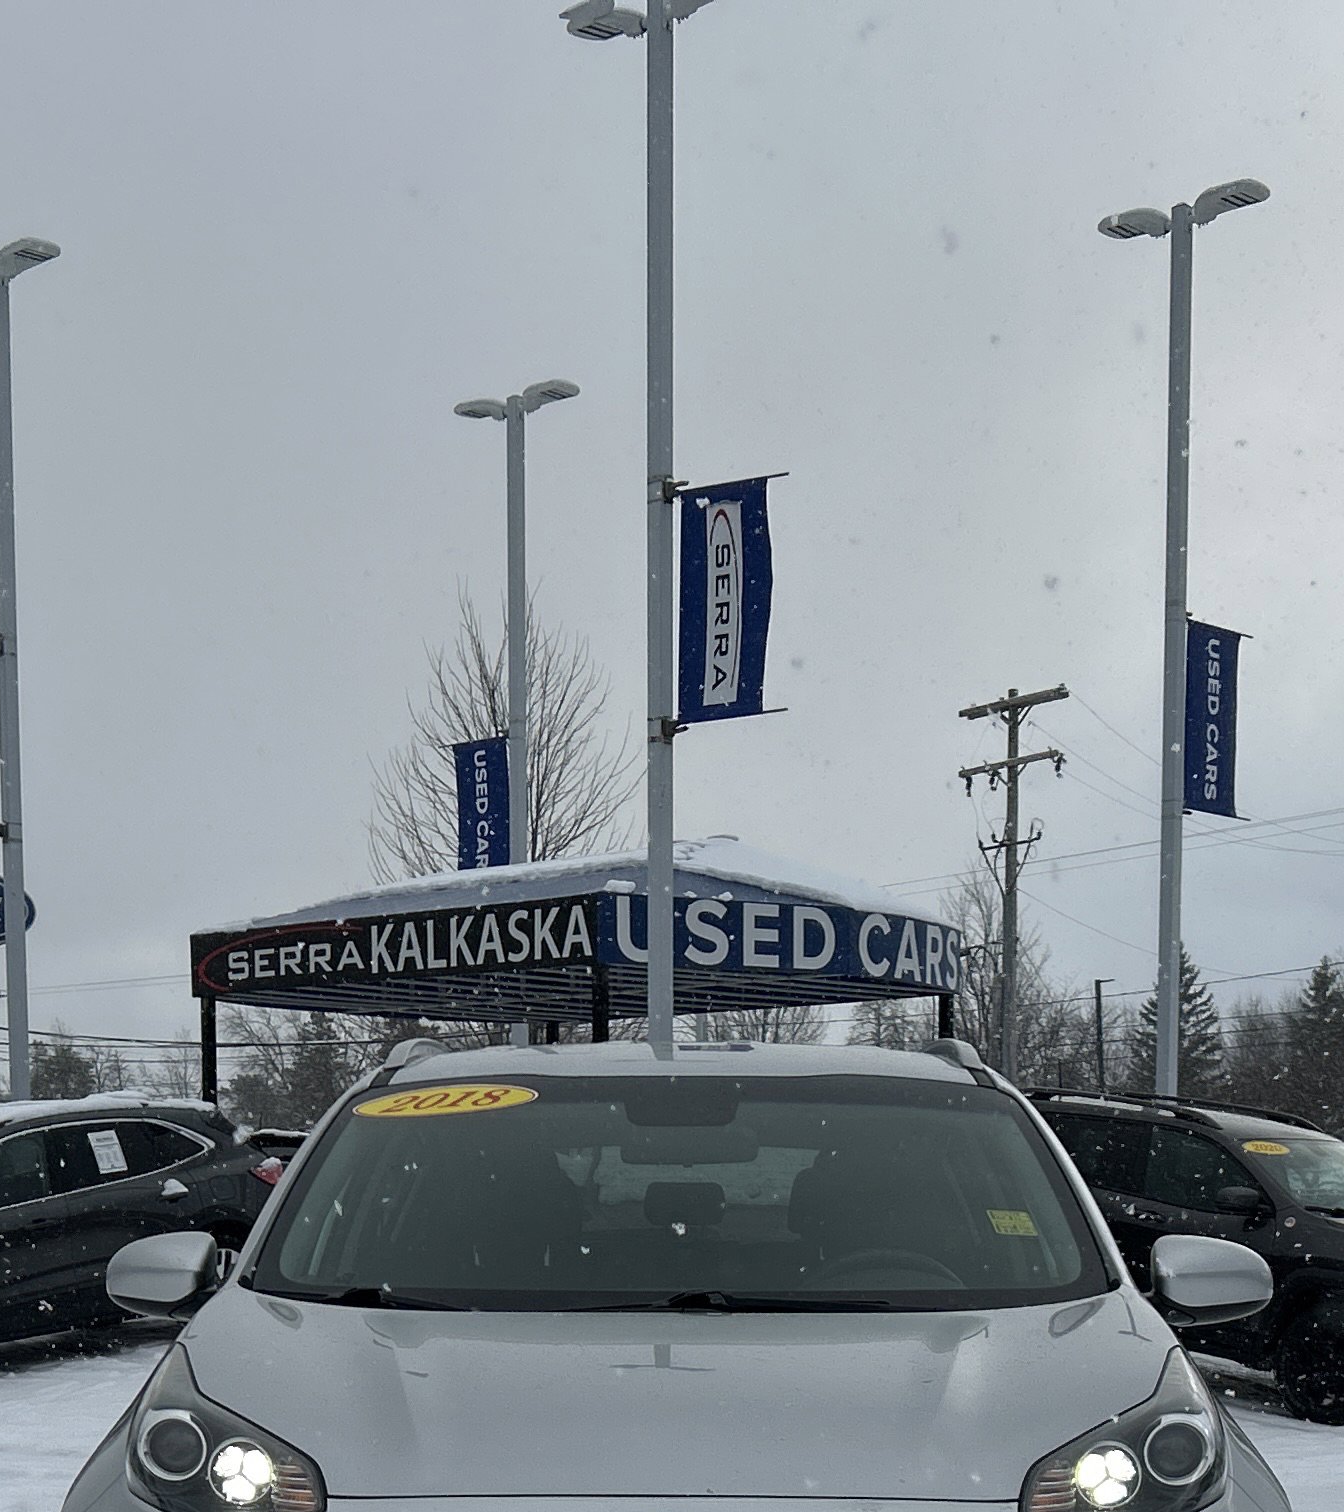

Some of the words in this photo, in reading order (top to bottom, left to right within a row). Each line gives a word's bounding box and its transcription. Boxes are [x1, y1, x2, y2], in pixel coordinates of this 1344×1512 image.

[711, 543, 731, 691] SERRA
[1206, 638, 1222, 716] USED
[473, 749, 489, 815] USED
[1203, 723, 1220, 801] CARS
[475, 820, 490, 868] CAR
[227, 940, 366, 981] SERRA
[370, 904, 594, 975] KALKASKA
[615, 895, 837, 971] USED
[857, 913, 959, 991] CARS
[378, 1088, 512, 1115] 2018
